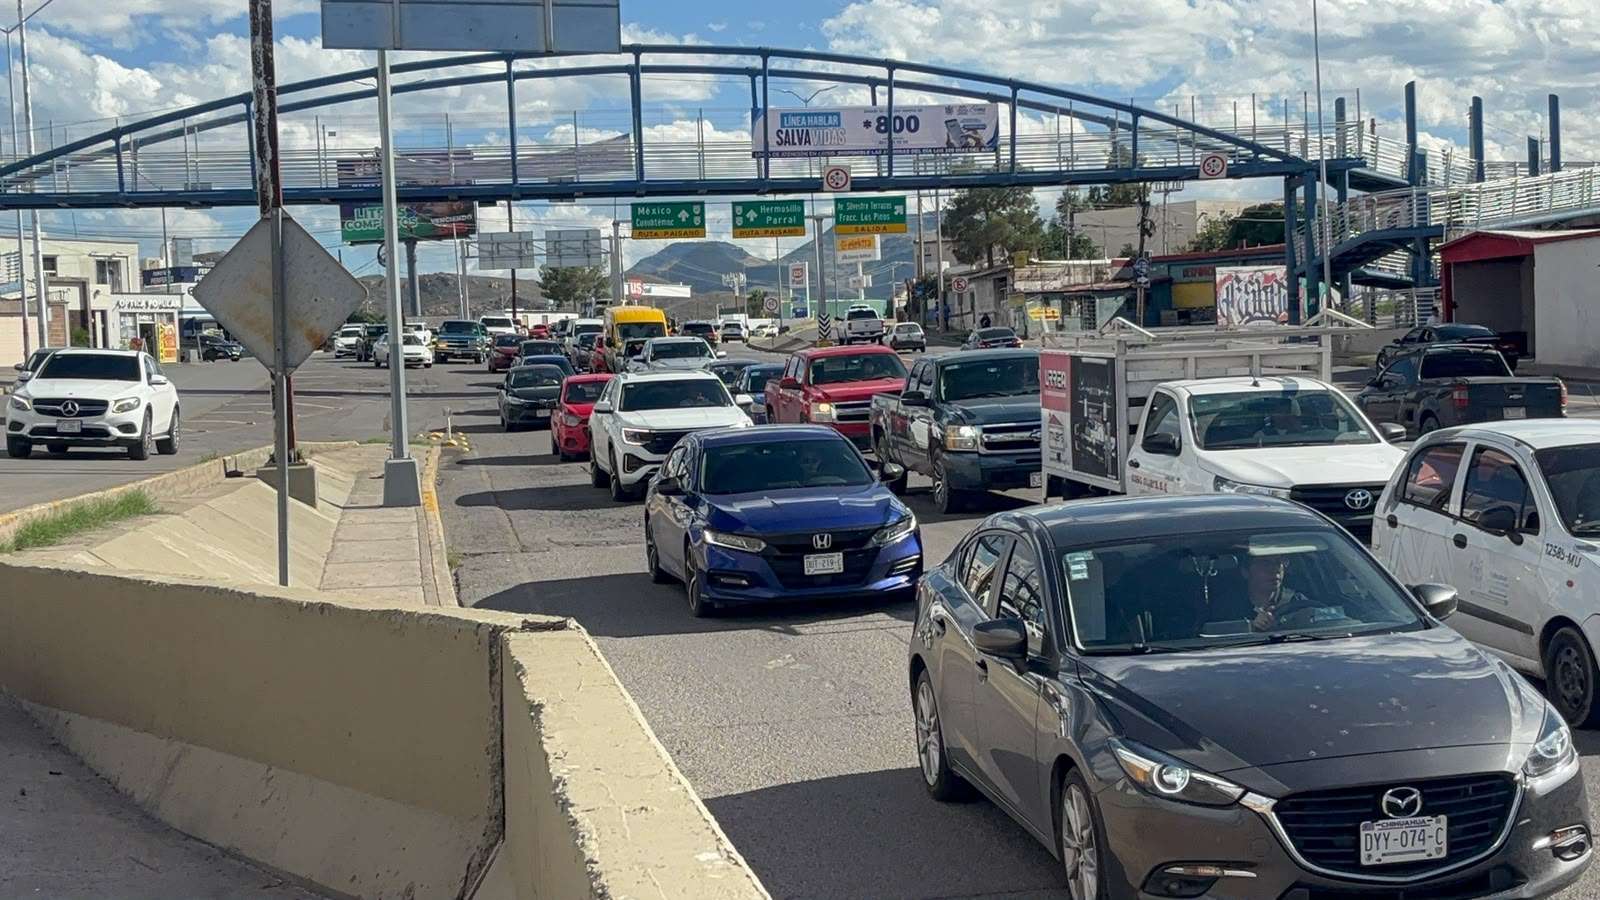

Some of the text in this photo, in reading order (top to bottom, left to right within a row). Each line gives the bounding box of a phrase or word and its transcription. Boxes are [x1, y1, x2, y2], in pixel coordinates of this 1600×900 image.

[784, 114, 839, 126] LÍNEA HABLAR
[776, 128, 846, 146] SALVAVIDAS
[353, 206, 407, 220] LITRS
[637, 206, 672, 216] México
[760, 204, 802, 214] Hermosillo
[766, 216, 797, 225] Parral
[854, 225, 888, 233] SALIDA
[1380, 818, 1427, 828] CHIHUAHUA
[1364, 827, 1445, 852] DYY-074-C
